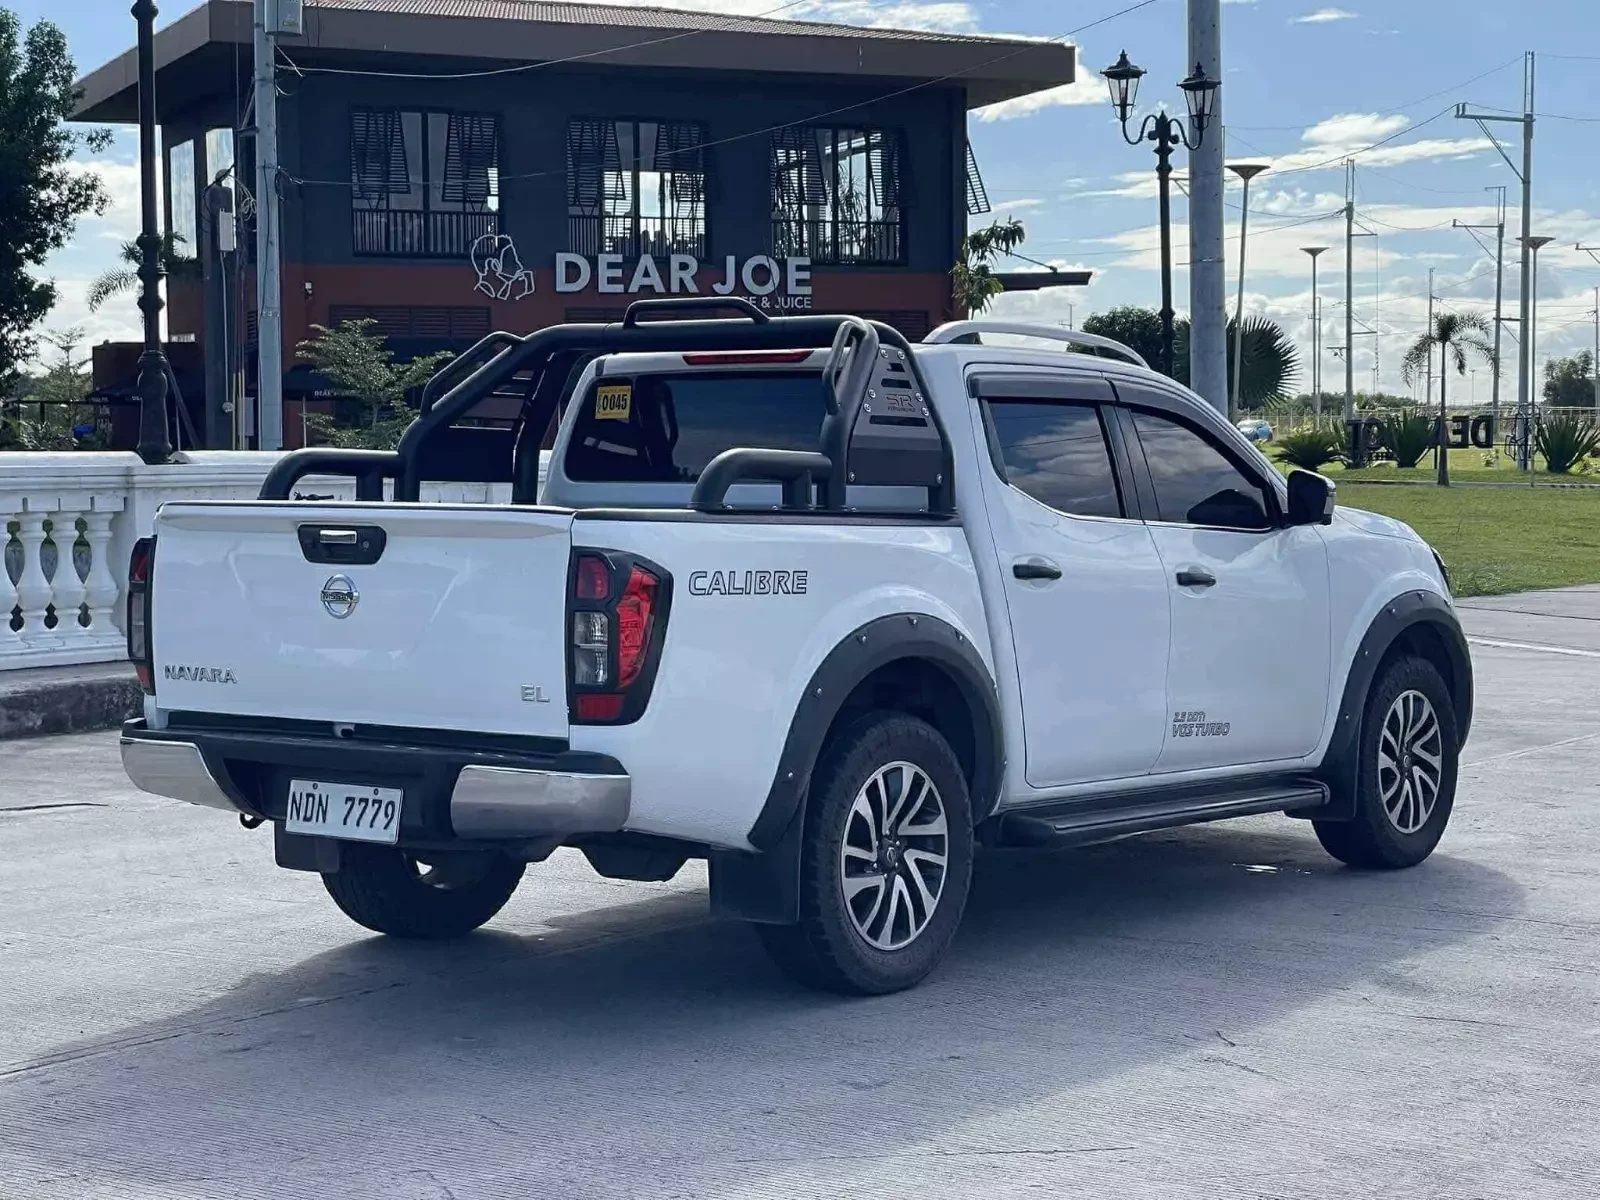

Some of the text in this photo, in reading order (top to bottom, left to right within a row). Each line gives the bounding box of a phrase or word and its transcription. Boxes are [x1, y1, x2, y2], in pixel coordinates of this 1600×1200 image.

[555, 252, 812, 296] DEAR JOE
[761, 296, 771, 308] &
[774, 296, 812, 309] JUICE
[688, 570, 808, 596] CALIBRE
[164, 664, 238, 684] NAVARA
[520, 684, 551, 703] EL
[1195, 722, 1231, 737] TURBO
[290, 791, 396, 830] NDN 7779
